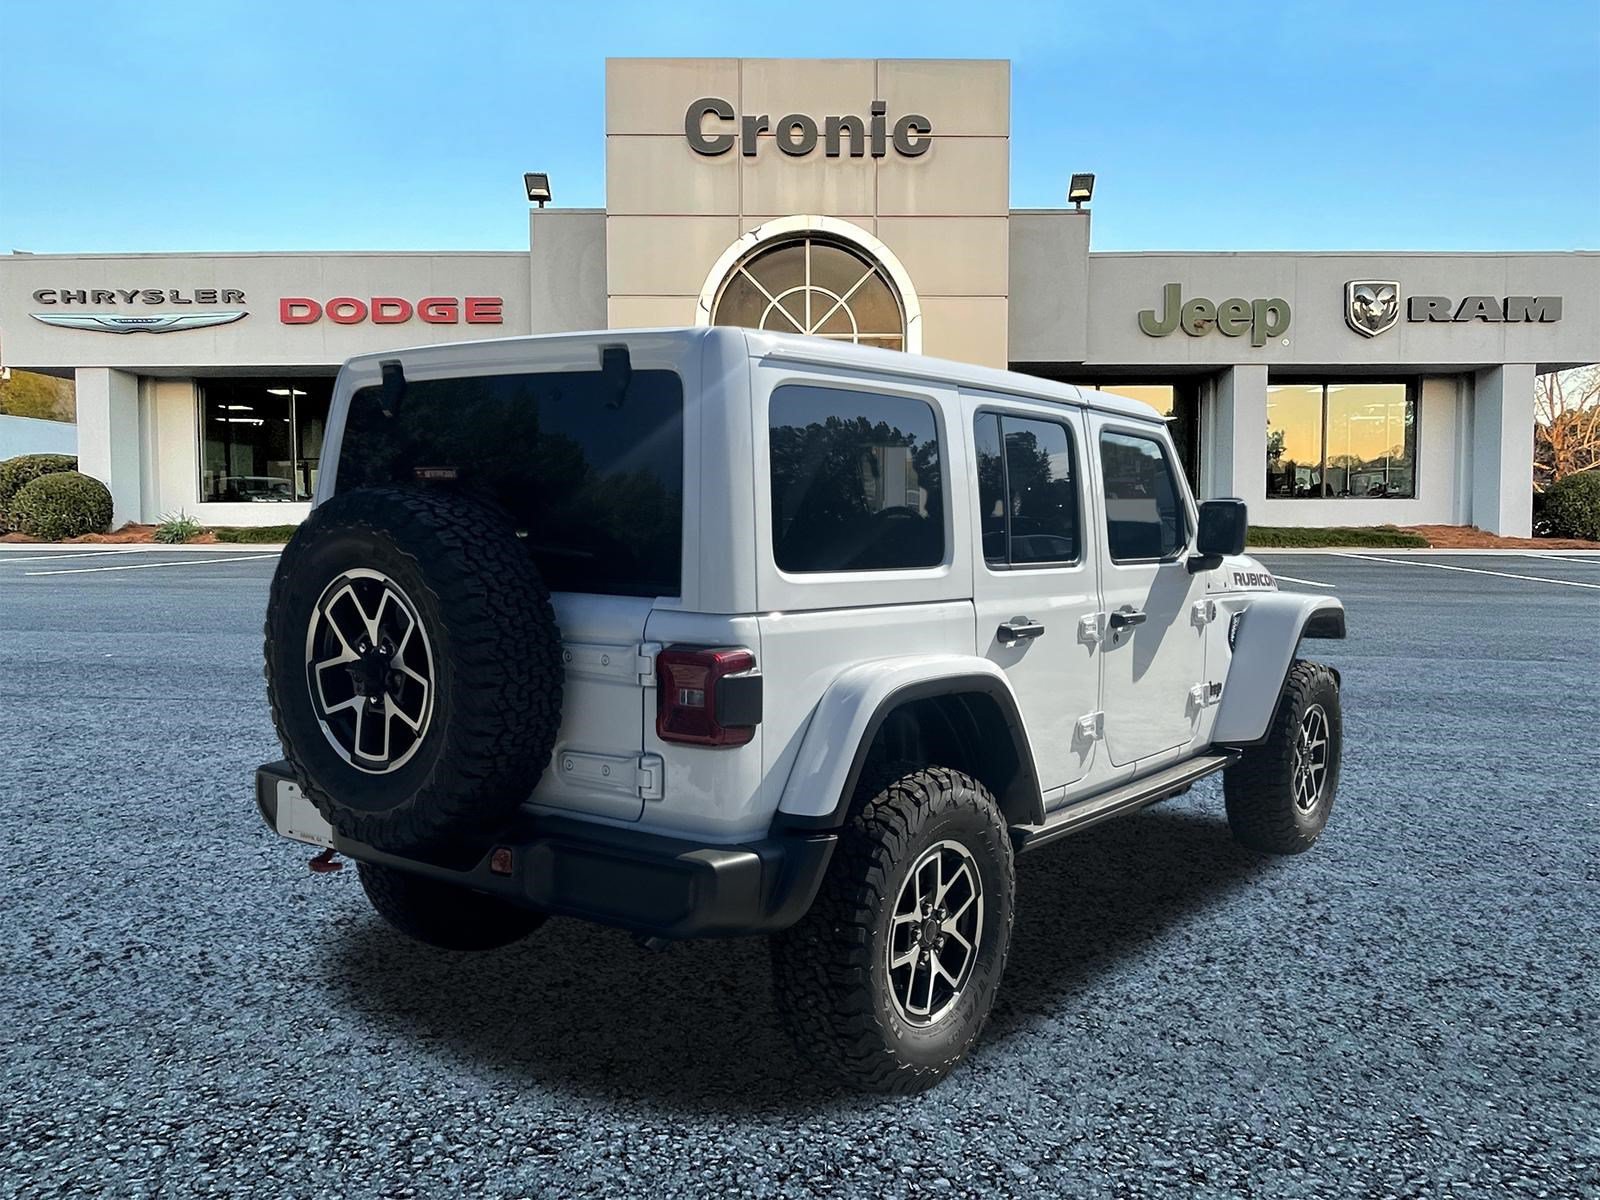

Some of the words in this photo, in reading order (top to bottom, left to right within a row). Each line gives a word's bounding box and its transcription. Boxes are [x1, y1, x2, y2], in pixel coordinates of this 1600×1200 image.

[685, 97, 932, 157] Cronic
[32, 289, 247, 305] CHRYSLER
[1407, 296, 1563, 323] RAM
[279, 297, 503, 325] DODGE
[1138, 283, 1291, 347] Jeep
[1233, 572, 1277, 587] RUBICON
